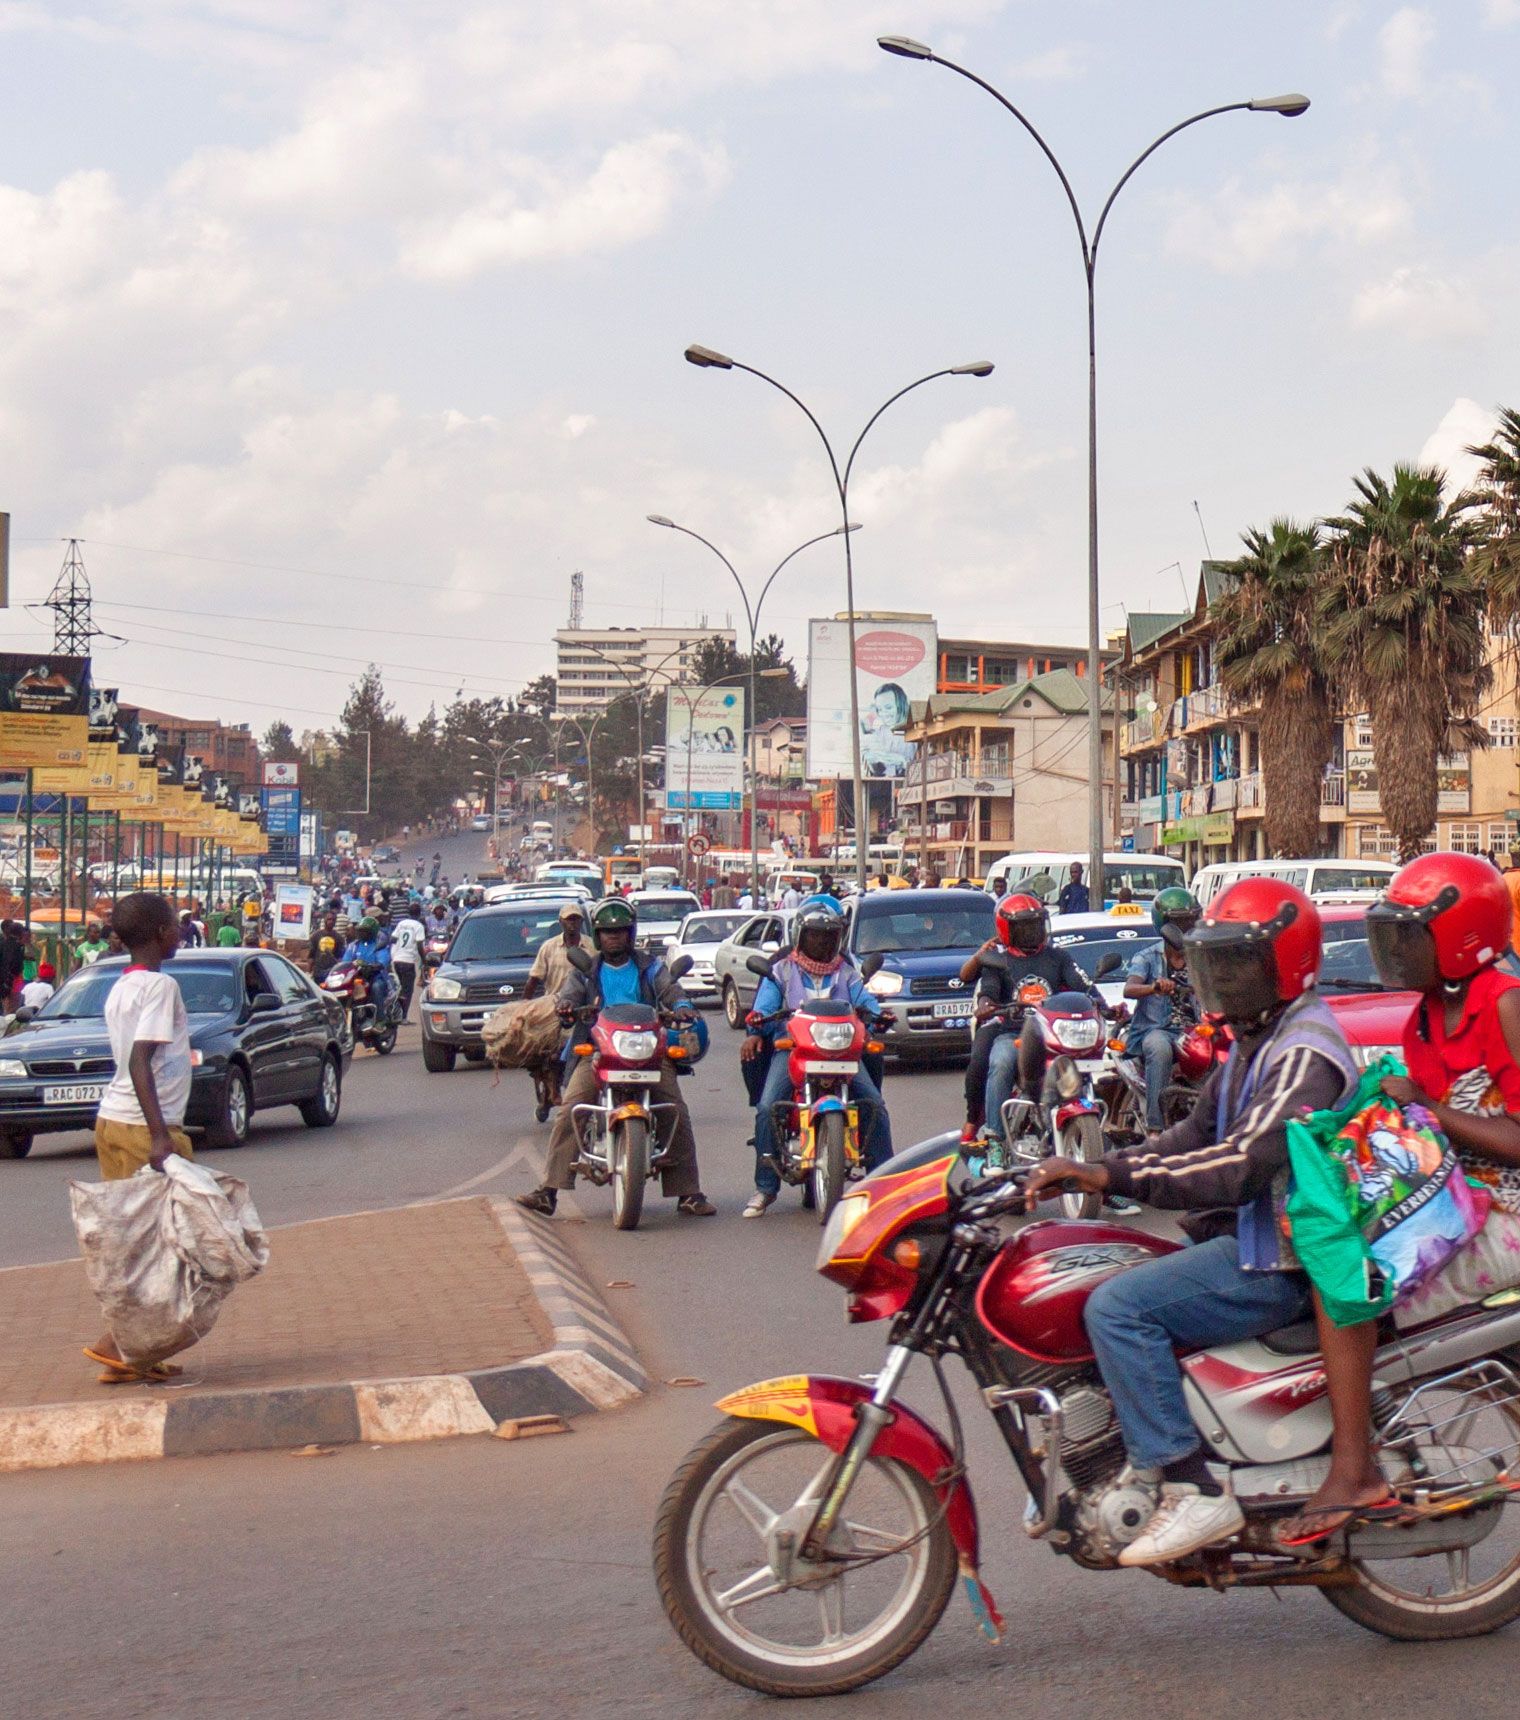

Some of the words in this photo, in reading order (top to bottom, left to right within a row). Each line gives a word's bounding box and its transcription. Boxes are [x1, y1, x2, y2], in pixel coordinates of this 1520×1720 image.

[1116, 906, 1139, 914] TAXI
[401, 931, 410, 948] 9
[942, 1004, 958, 1016] RAD
[52, 1088, 73, 1101] RAC
[75, 1086, 95, 1100] 072
[1051, 1250, 1128, 1274] GLX
